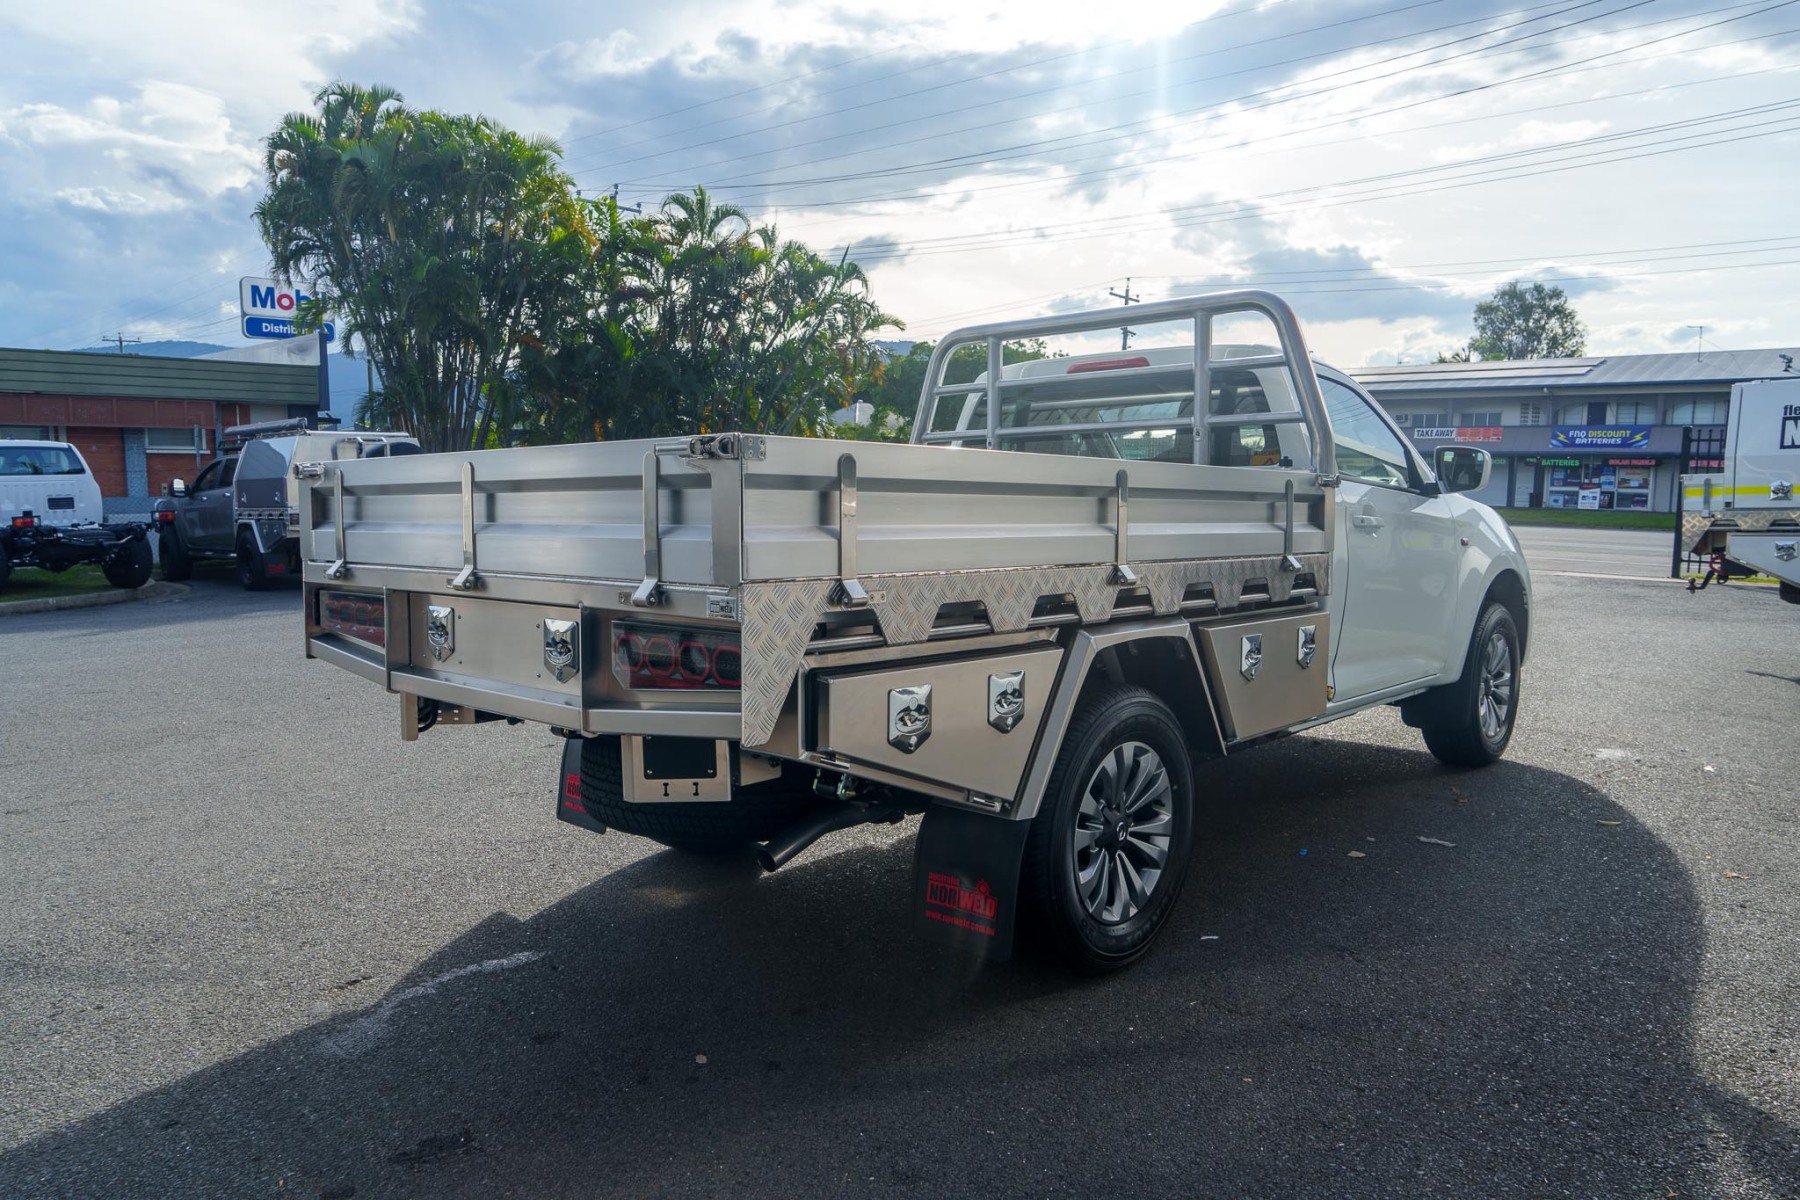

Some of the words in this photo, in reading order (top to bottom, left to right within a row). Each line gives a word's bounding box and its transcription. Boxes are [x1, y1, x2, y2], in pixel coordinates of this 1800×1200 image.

[1416, 429, 1435, 437] TAKE
[1435, 429, 1454, 437] AWAY
[1569, 430, 1587, 438] FNQ
[1588, 430, 1632, 438] DISCOUNT
[1575, 437, 1622, 445] BATTERIES
[1541, 459, 1580, 467] BATTERIES
